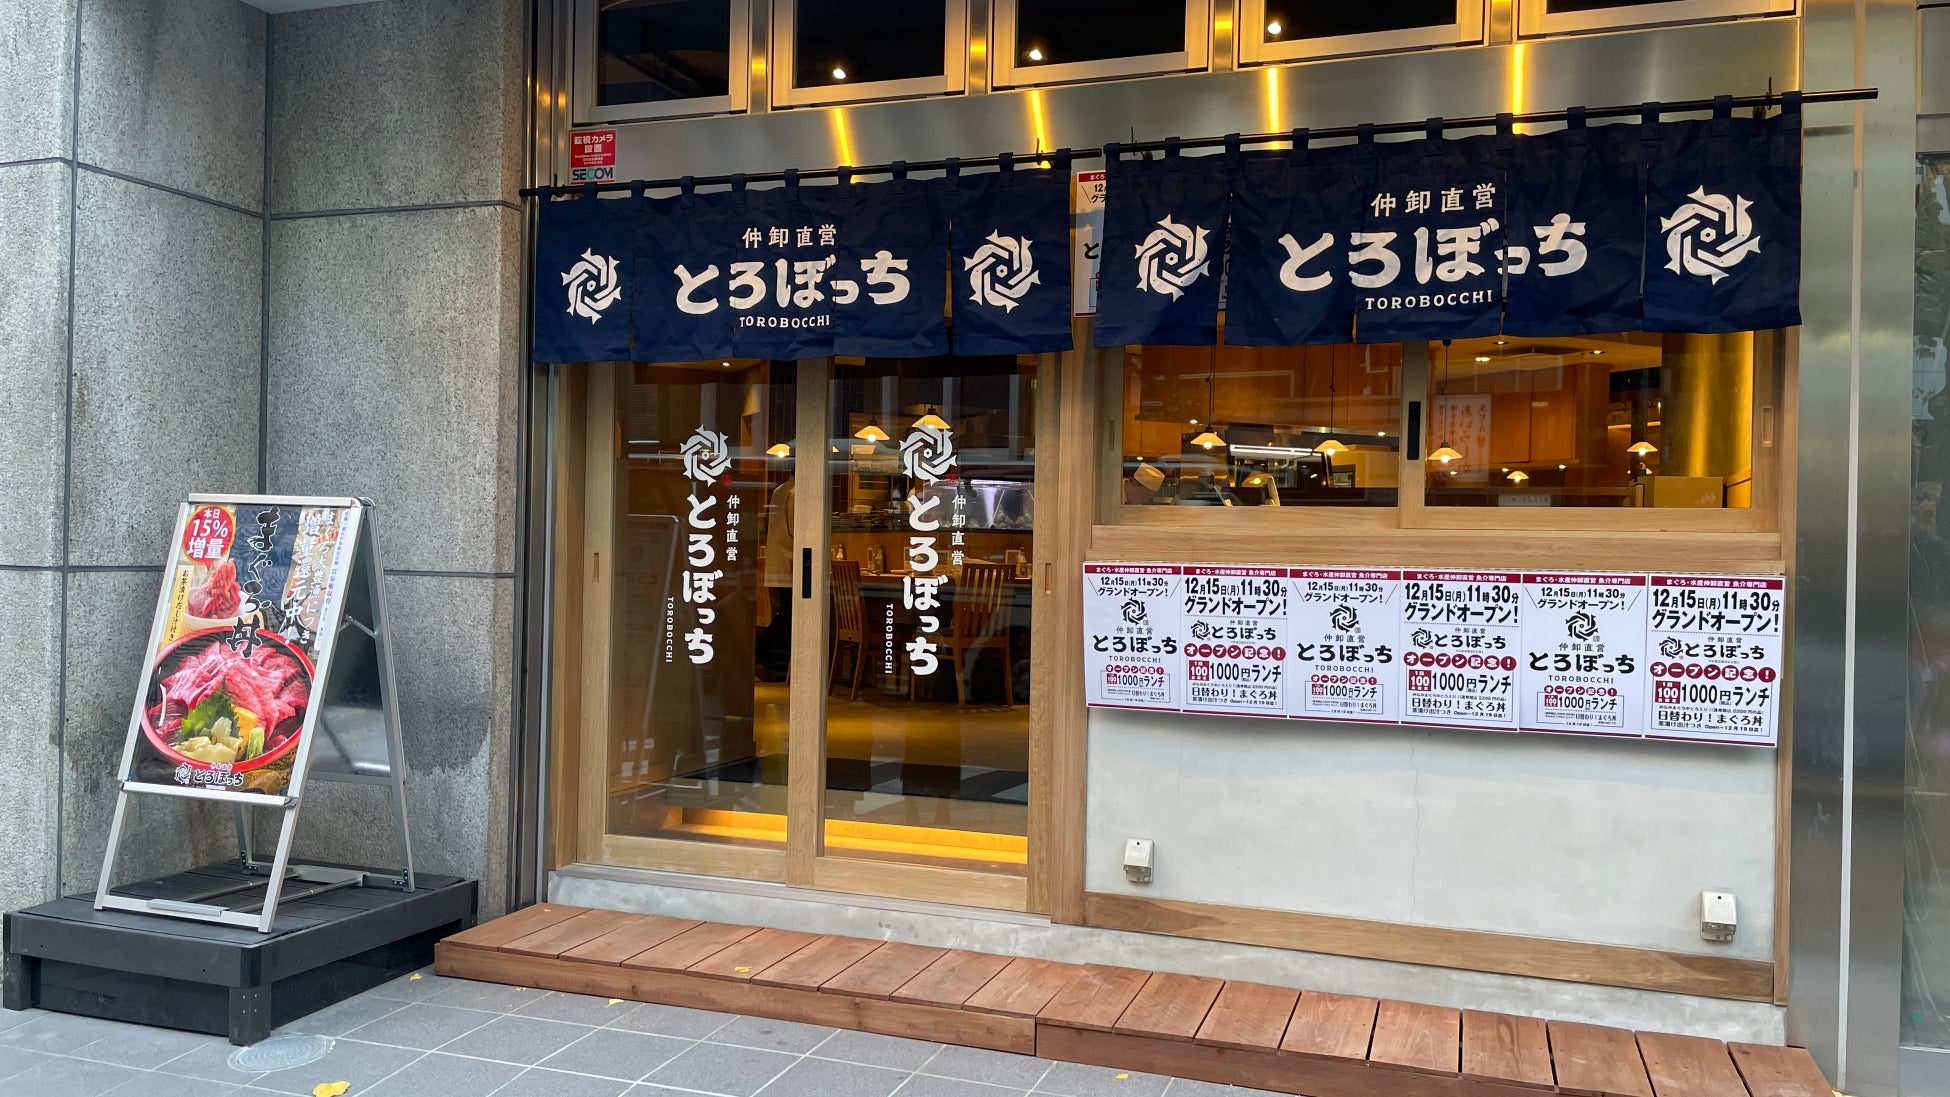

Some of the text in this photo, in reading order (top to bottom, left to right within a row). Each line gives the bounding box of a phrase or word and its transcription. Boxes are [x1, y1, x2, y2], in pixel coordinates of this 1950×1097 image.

[572, 167, 613, 181] SECOM
[1371, 182, 1496, 217] 仲卸直営
[742, 224, 837, 248] 仲卸直営
[1278, 212, 1588, 291] とろぼっち
[673, 250, 911, 314] とろぼっち
[1365, 289, 1493, 310] TOROBOCCHI
[739, 315, 830, 328] TOROBOCCHI
[203, 508, 220, 519] 本日
[193, 519, 228, 538] 15%
[726, 495, 740, 562] 仲卸直営
[951, 495, 966, 566] 仲卸直営
[187, 537, 224, 559] 増量
[682, 494, 723, 664] とろぼっち
[903, 495, 948, 676] とろぼっち
[1185, 577, 1287, 597] 12月15日(月)11時30分
[1308, 582, 1383, 592] 12月15日(月)11時30分
[1098, 587, 1168, 597] グランドオープン！
[1304, 592, 1382, 603] グランドオープン！
[1405, 583, 1519, 604] 12月15日(月)11時30分
[1541, 587, 1625, 598] 12月15日(月)11時30分
[1653, 588, 1780, 611] 12月15日(月)11時30分
[1185, 595, 1287, 616] グランドオープン！
[1404, 601, 1518, 624] グランドオープン！
[1537, 599, 1625, 610] グランドオープン！
[666, 597, 674, 663] TOROBOCCHI
[1652, 608, 1779, 633] グランドオープン！
[885, 603, 893, 674] TOROBOCCHI
[1116, 626, 1153, 635] 仲卸直営
[1212, 626, 1276, 640] とろぼっち
[1324, 634, 1365, 643] 仲卸直営
[1093, 635, 1177, 654] とろぼっち
[1434, 634, 1506, 649] とろぼっち
[1559, 643, 1605, 652] 仲卸直営
[1685, 642, 1765, 660] とろぼっち
[1185, 644, 1283, 659] オープン記念！
[1297, 643, 1392, 664] とろぼっち
[1405, 653, 1514, 669] オープン記念！
[1191, 666, 1208, 676] 100
[1210, 662, 1281, 683] 1000円ランチ
[1315, 665, 1374, 673] TOROBOCCHI
[1529, 652, 1635, 674] とろぼっち
[1652, 663, 1772, 681] オープン記念！
[1411, 676, 1429, 686] 100
[1432, 672, 1511, 694] 1000円ランチ
[1548, 675, 1614, 684] TOROBOCCHI
[1658, 687, 1678, 699] 100
[1682, 683, 1769, 707] 1000円ランチ
[194, 769, 244, 786] とろぼっち
